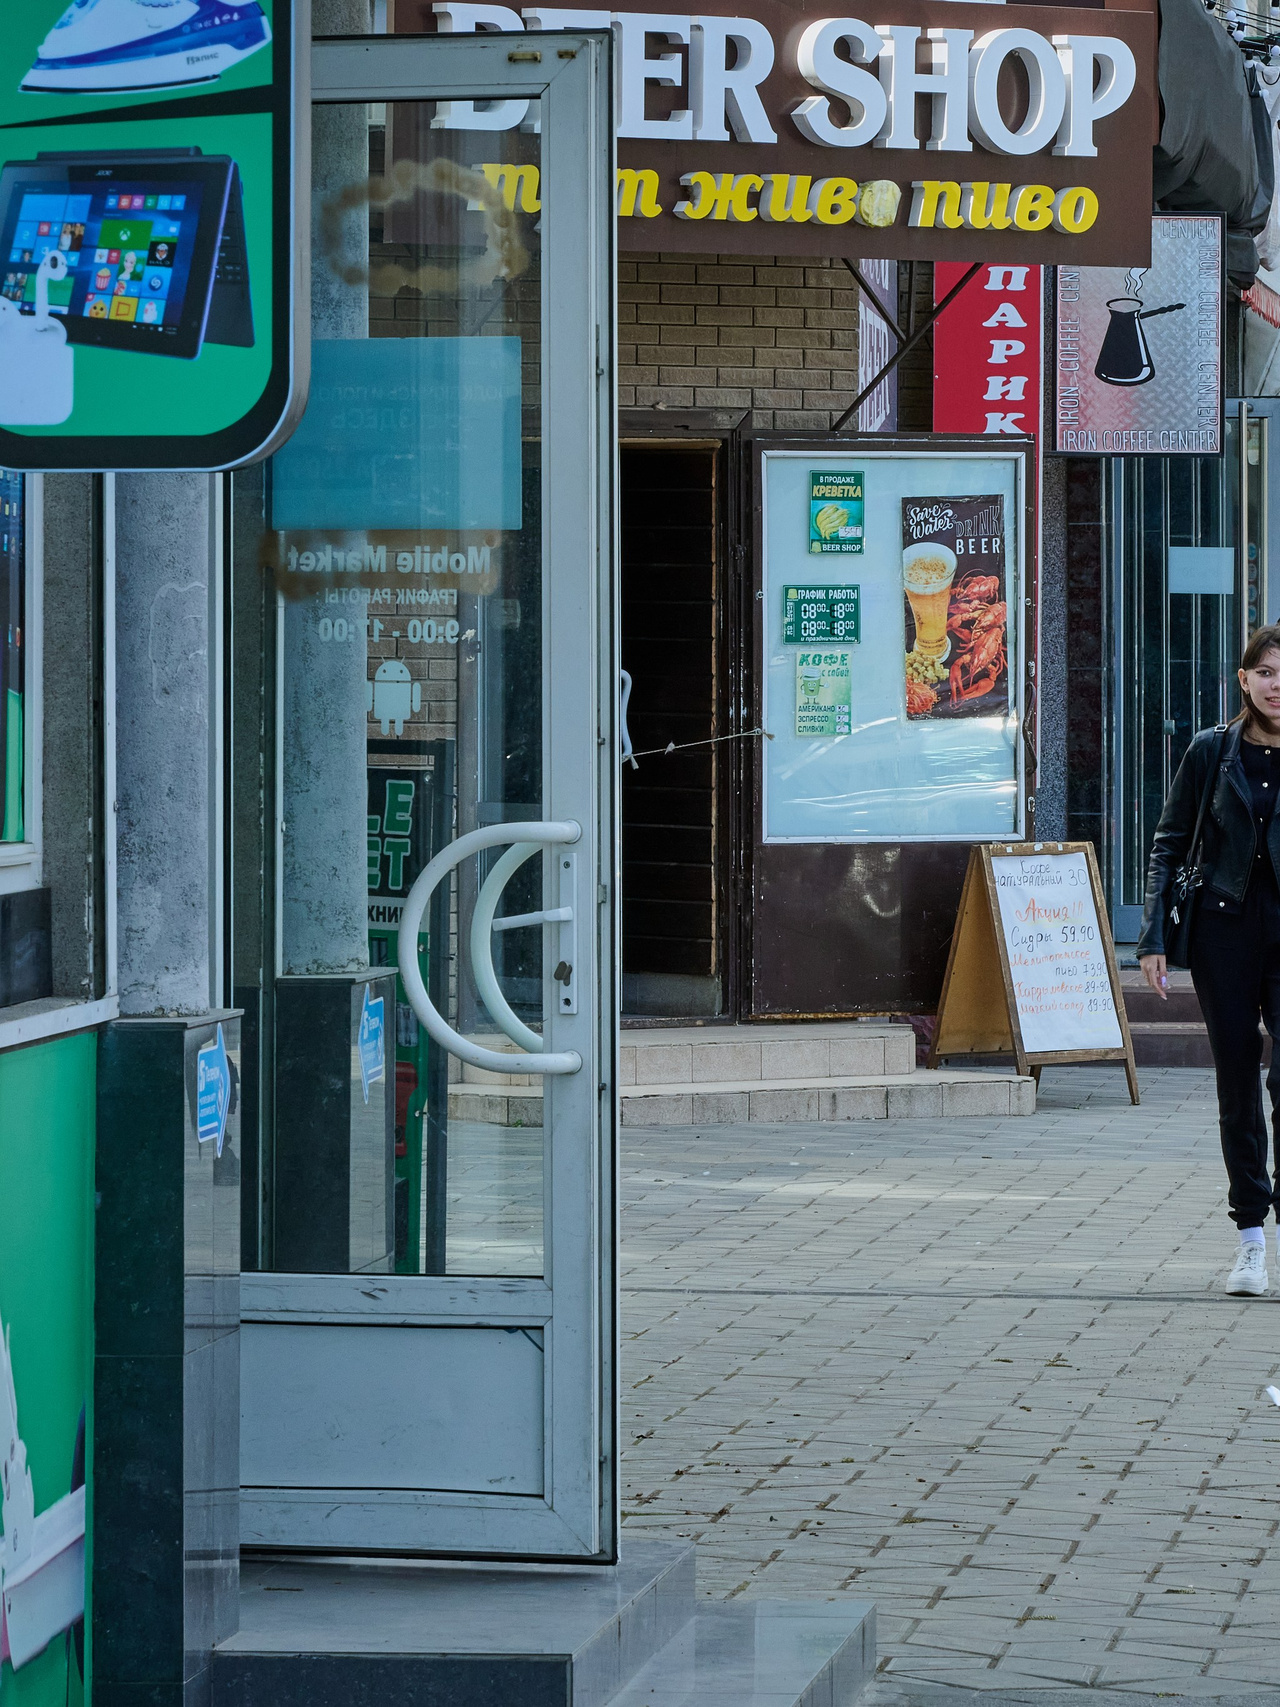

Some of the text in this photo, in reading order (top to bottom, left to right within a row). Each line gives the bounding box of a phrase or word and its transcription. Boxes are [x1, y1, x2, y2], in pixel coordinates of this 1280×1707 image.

[791, 17, 1137, 157] SHOP
[908, 180, 1099, 234] пиво
[1160, 219, 1217, 240] CENTER
[1059, 316, 1081, 372] COFFEE
[1197, 244, 1220, 428] IRON COFFEE CENTER
[1059, 386, 1081, 426] IRON
[1062, 429, 1218, 452] IRON COFFEE CENTER
[824, 476, 855, 484] ПРОДАЖЕ
[813, 485, 861, 497] КРЕВЕТКА
[909, 504, 941, 526] Save
[909, 509, 954, 540] Water
[955, 506, 1000, 537] DRINK
[842, 544, 861, 552] SHOP
[956, 538, 1000, 554] BEER
[798, 589, 857, 600] ГРАФИК РАБОТЫ
[798, 653, 849, 667] КОФЕ
[797, 715, 829, 723] ЭСПРЕССО
[798, 705, 836, 713] АМЕРИКАНО
[1020, 859, 1051, 877] Кофе
[1068, 868, 1087, 887] 30
[1011, 926, 1053, 952] Сидры
[1055, 966, 1078, 977] пиво
